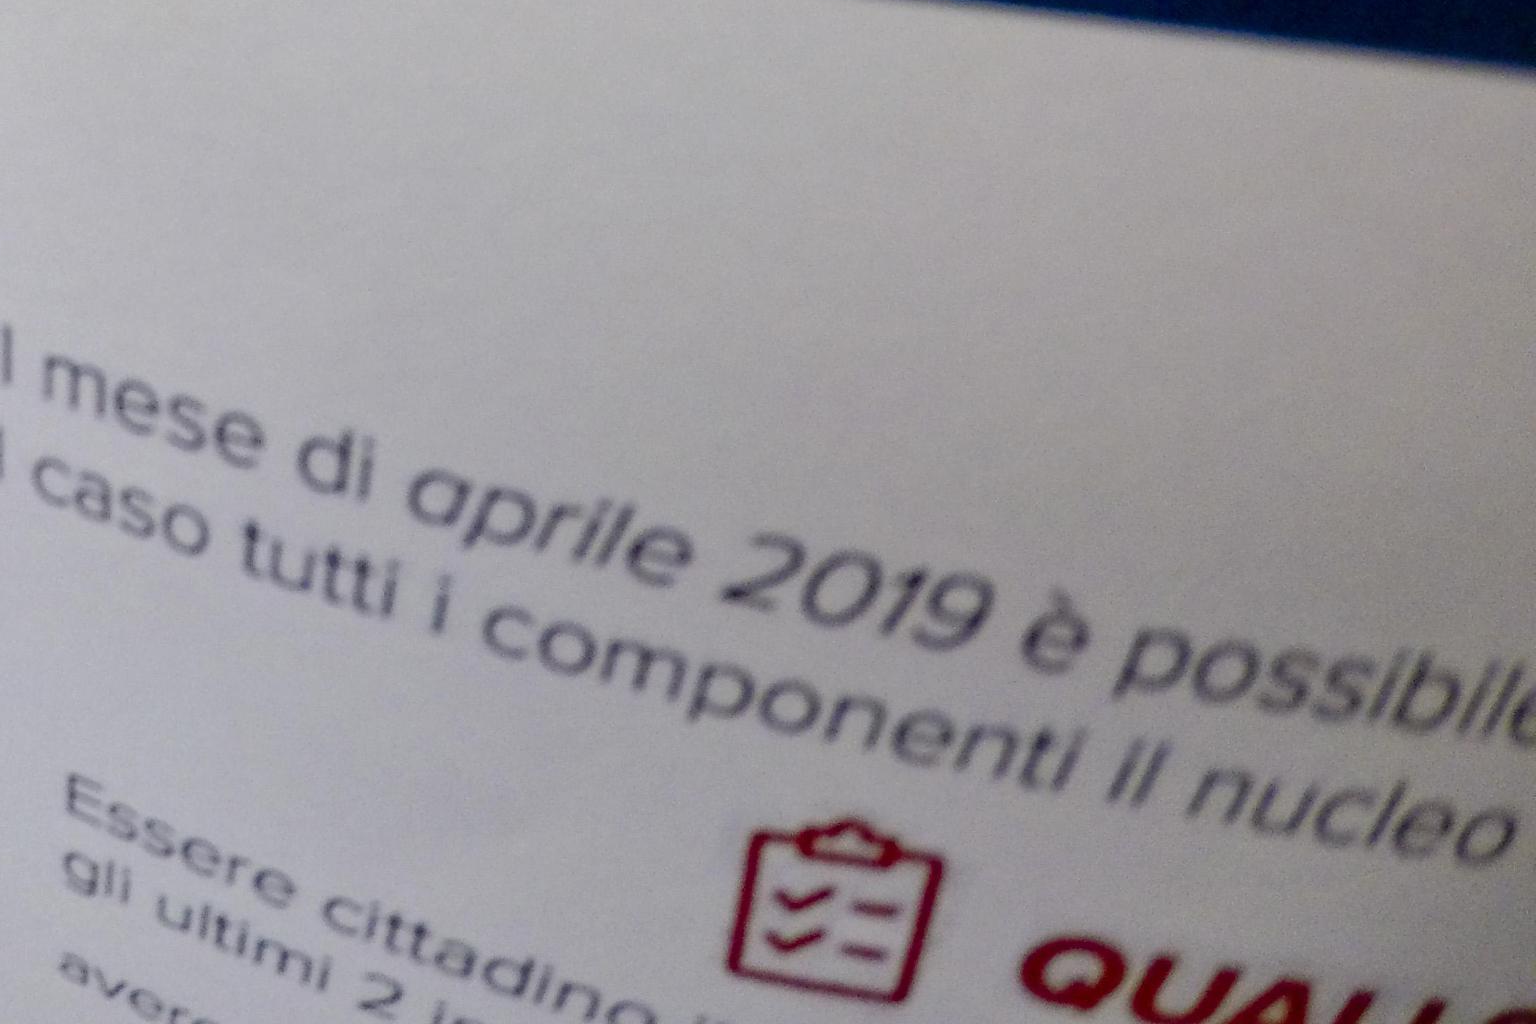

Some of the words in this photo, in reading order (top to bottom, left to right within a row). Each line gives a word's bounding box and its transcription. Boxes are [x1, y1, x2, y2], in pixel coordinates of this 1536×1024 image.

[41, 350, 267, 469] mese
[295, 427, 376, 503] di
[406, 464, 695, 589] aprile
[720, 531, 997, 652] 2019
[1021, 584, 1093, 674] è
[32, 446, 212, 558] caso
[241, 516, 399, 621] tutti
[429, 571, 452, 635] i
[482, 602, 1087, 792] componenti
[1106, 735, 1172, 806] il
[1186, 763, 1518, 871] nucleo
[65, 772, 298, 910] Essere
[58, 950, 220, 1024] aver
[62, 848, 132, 905] gli
[155, 891, 335, 994] ultimi
[358, 970, 406, 1023] 2
